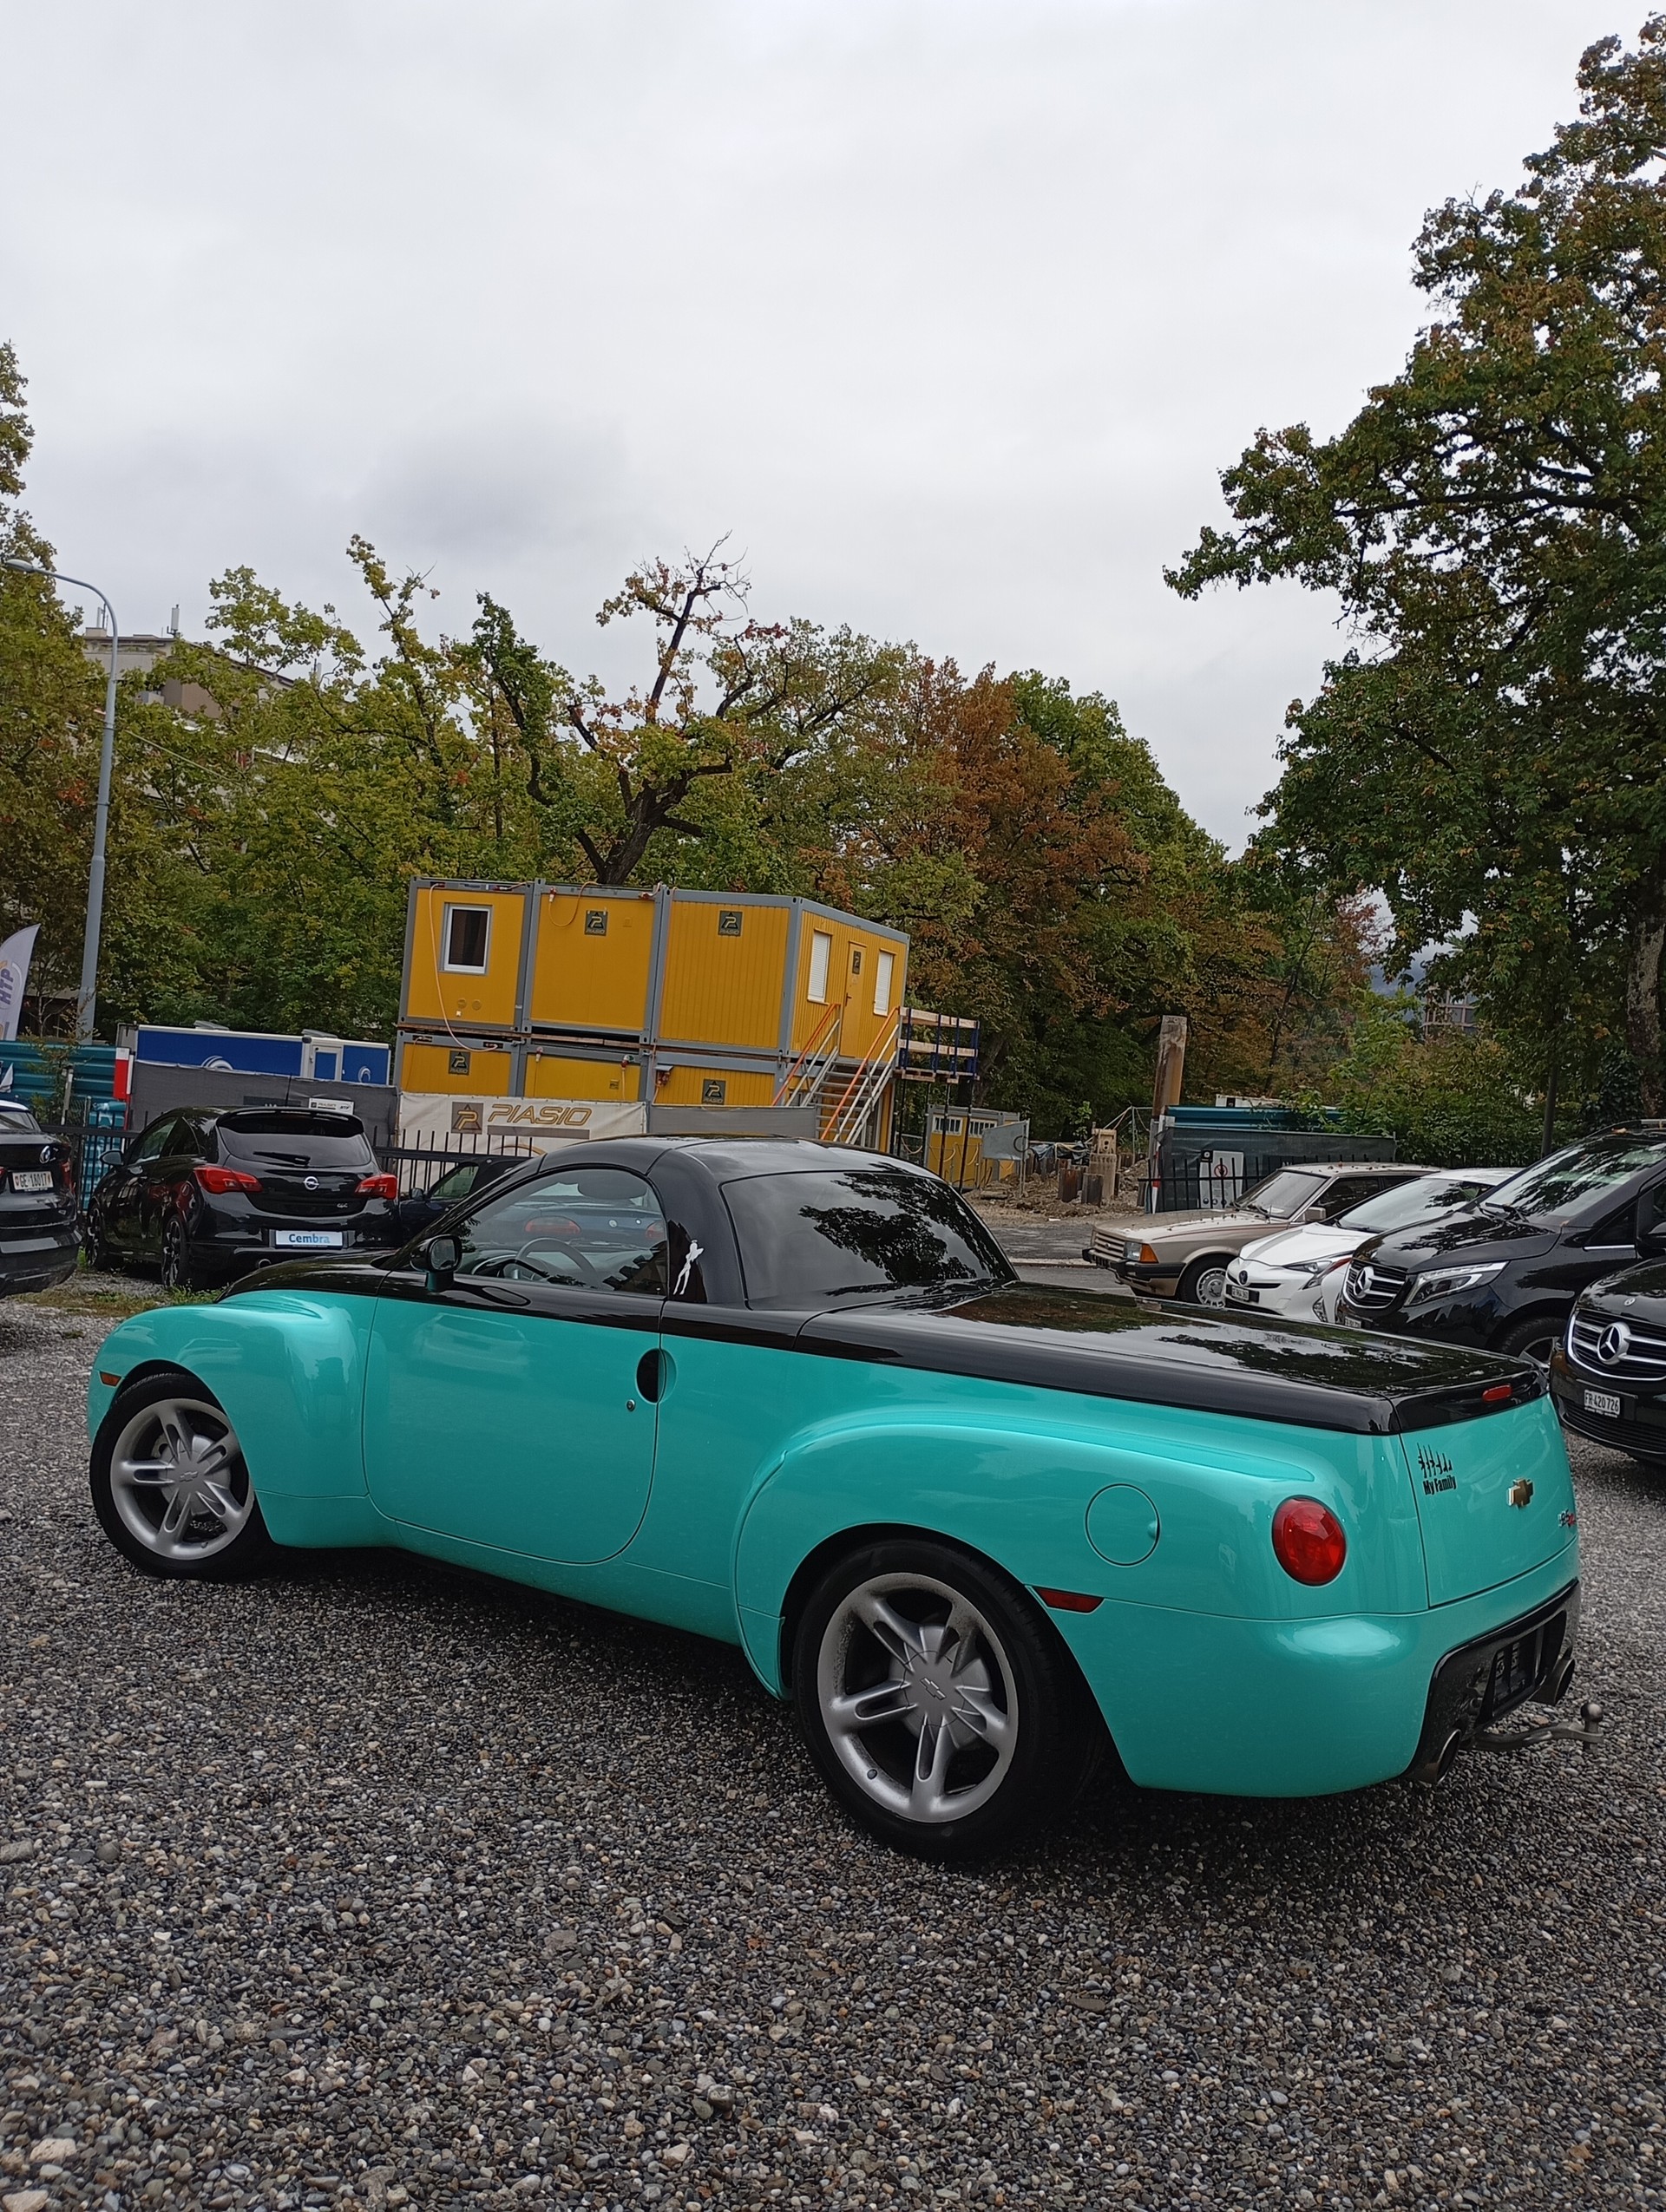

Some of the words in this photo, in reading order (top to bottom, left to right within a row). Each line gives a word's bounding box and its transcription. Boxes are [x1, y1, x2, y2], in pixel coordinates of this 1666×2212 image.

[488, 1103, 593, 1126] PIASIO
[288, 1234, 330, 1243] Cembra
[1422, 1480, 1434, 1495] My
[1433, 1475, 1457, 1493] Family
